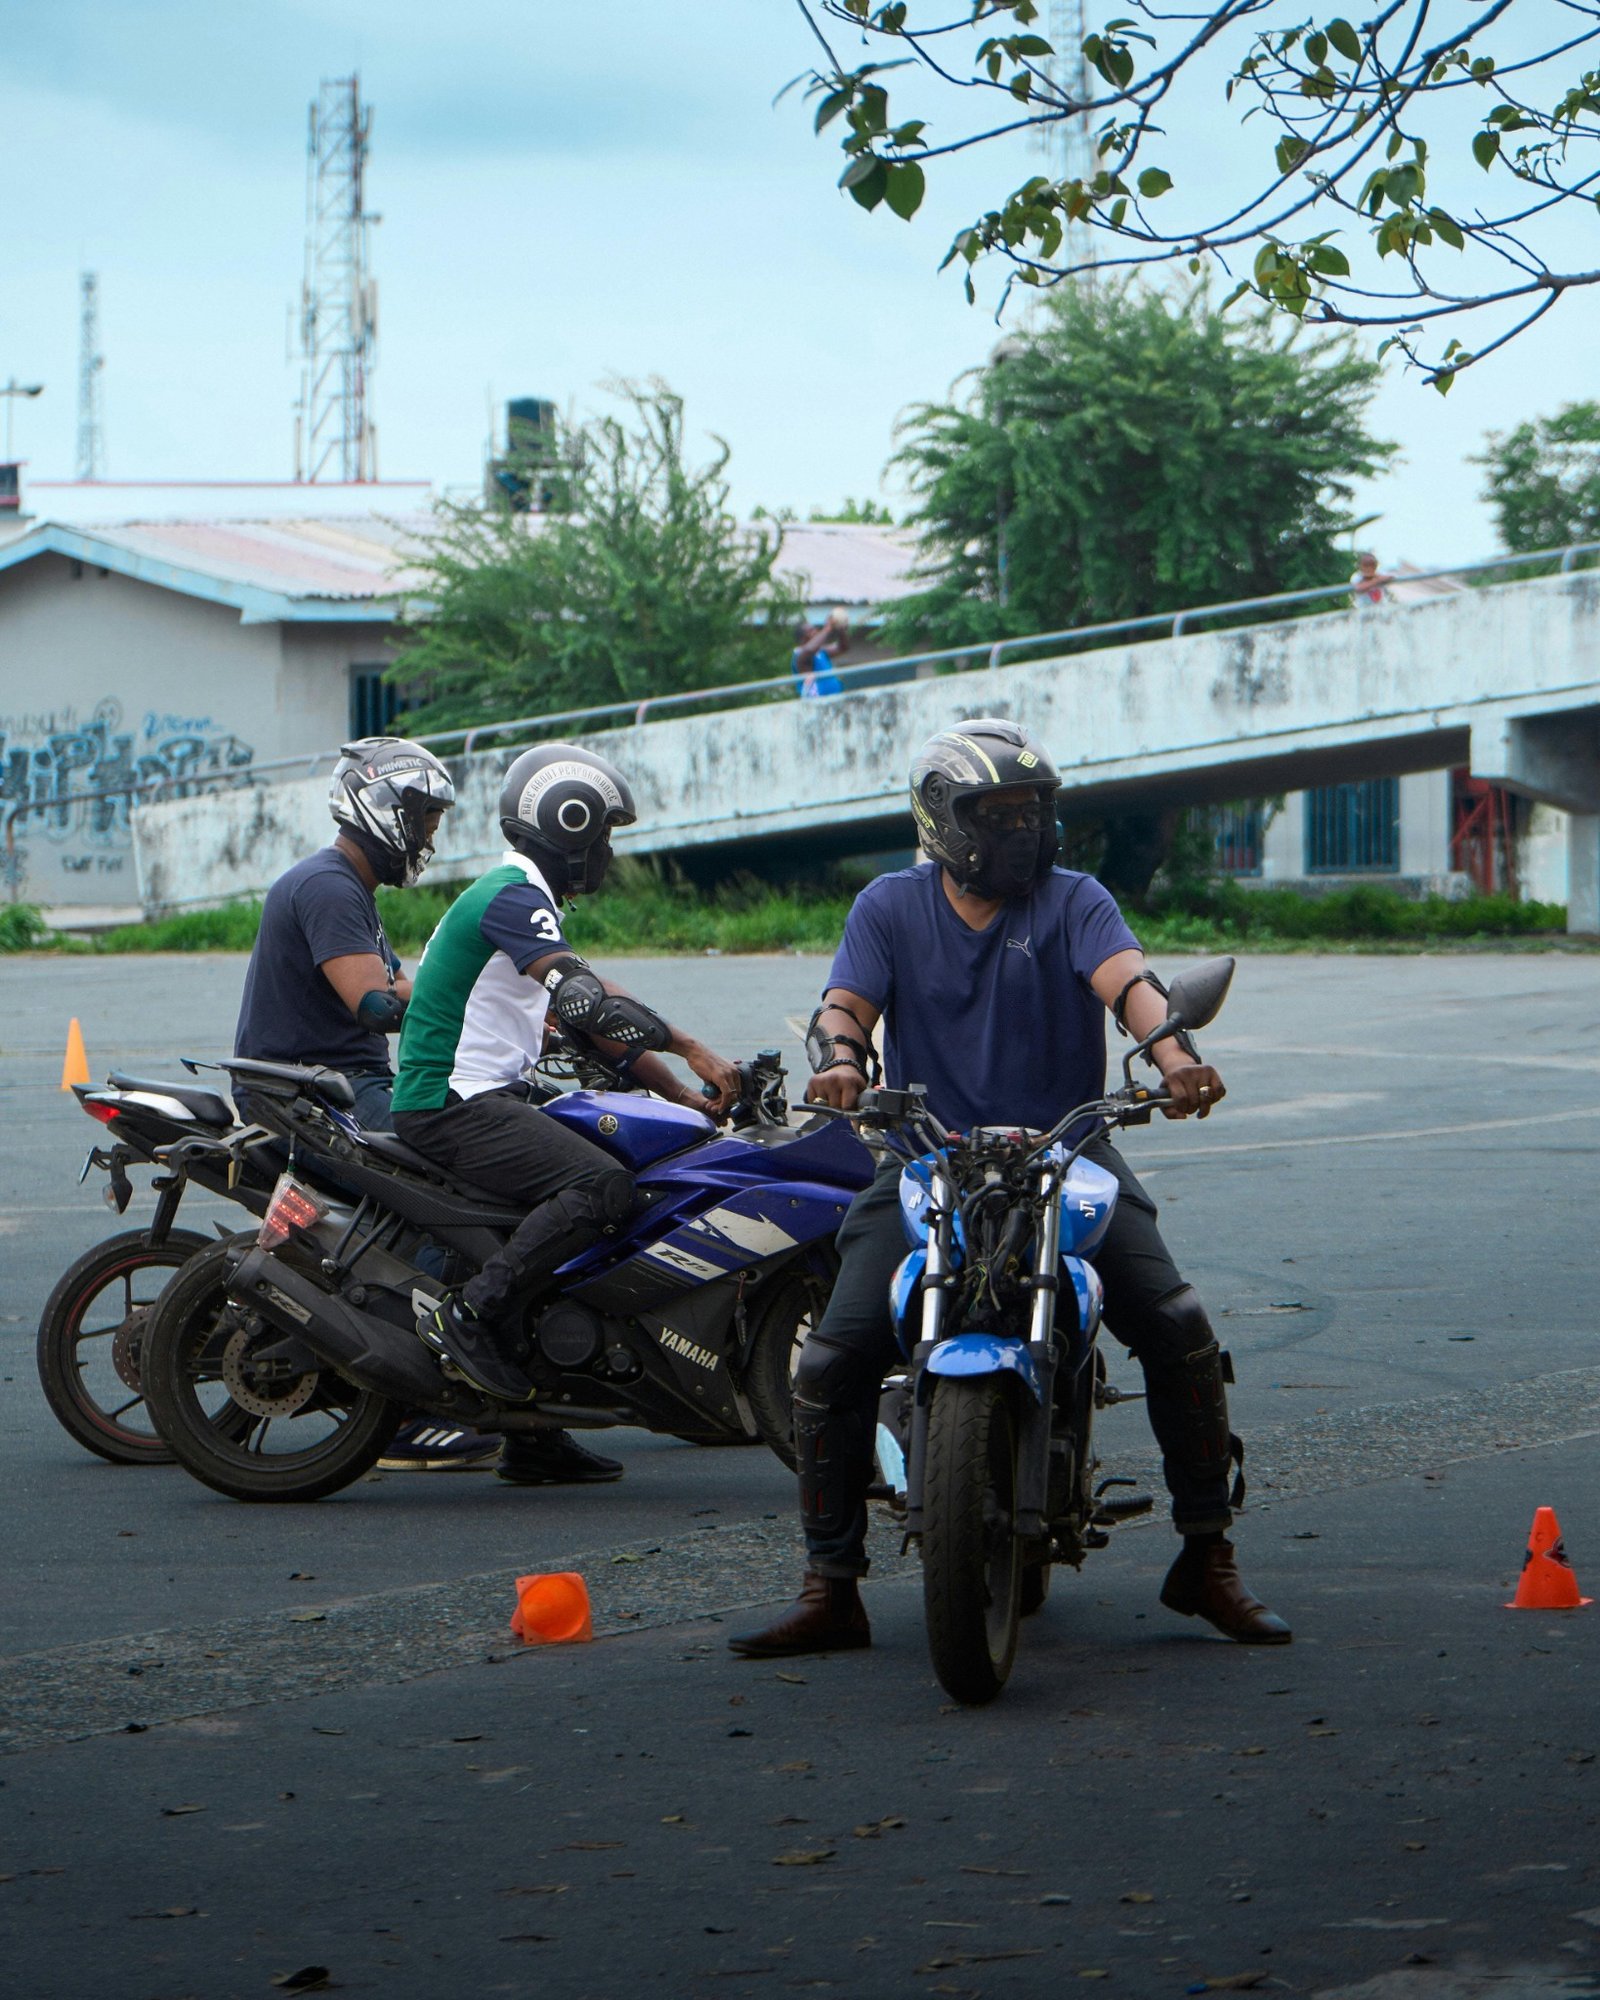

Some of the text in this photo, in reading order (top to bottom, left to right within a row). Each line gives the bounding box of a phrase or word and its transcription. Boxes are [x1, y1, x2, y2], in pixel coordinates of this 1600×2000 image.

[377, 758, 423, 775] MIMETIC
[522, 764, 618, 815] RAVE ABOUT PERFORMANCE
[530, 908, 561, 942] 3
[656, 1248, 709, 1272] R15
[658, 1326, 720, 1372] YAMAHA
